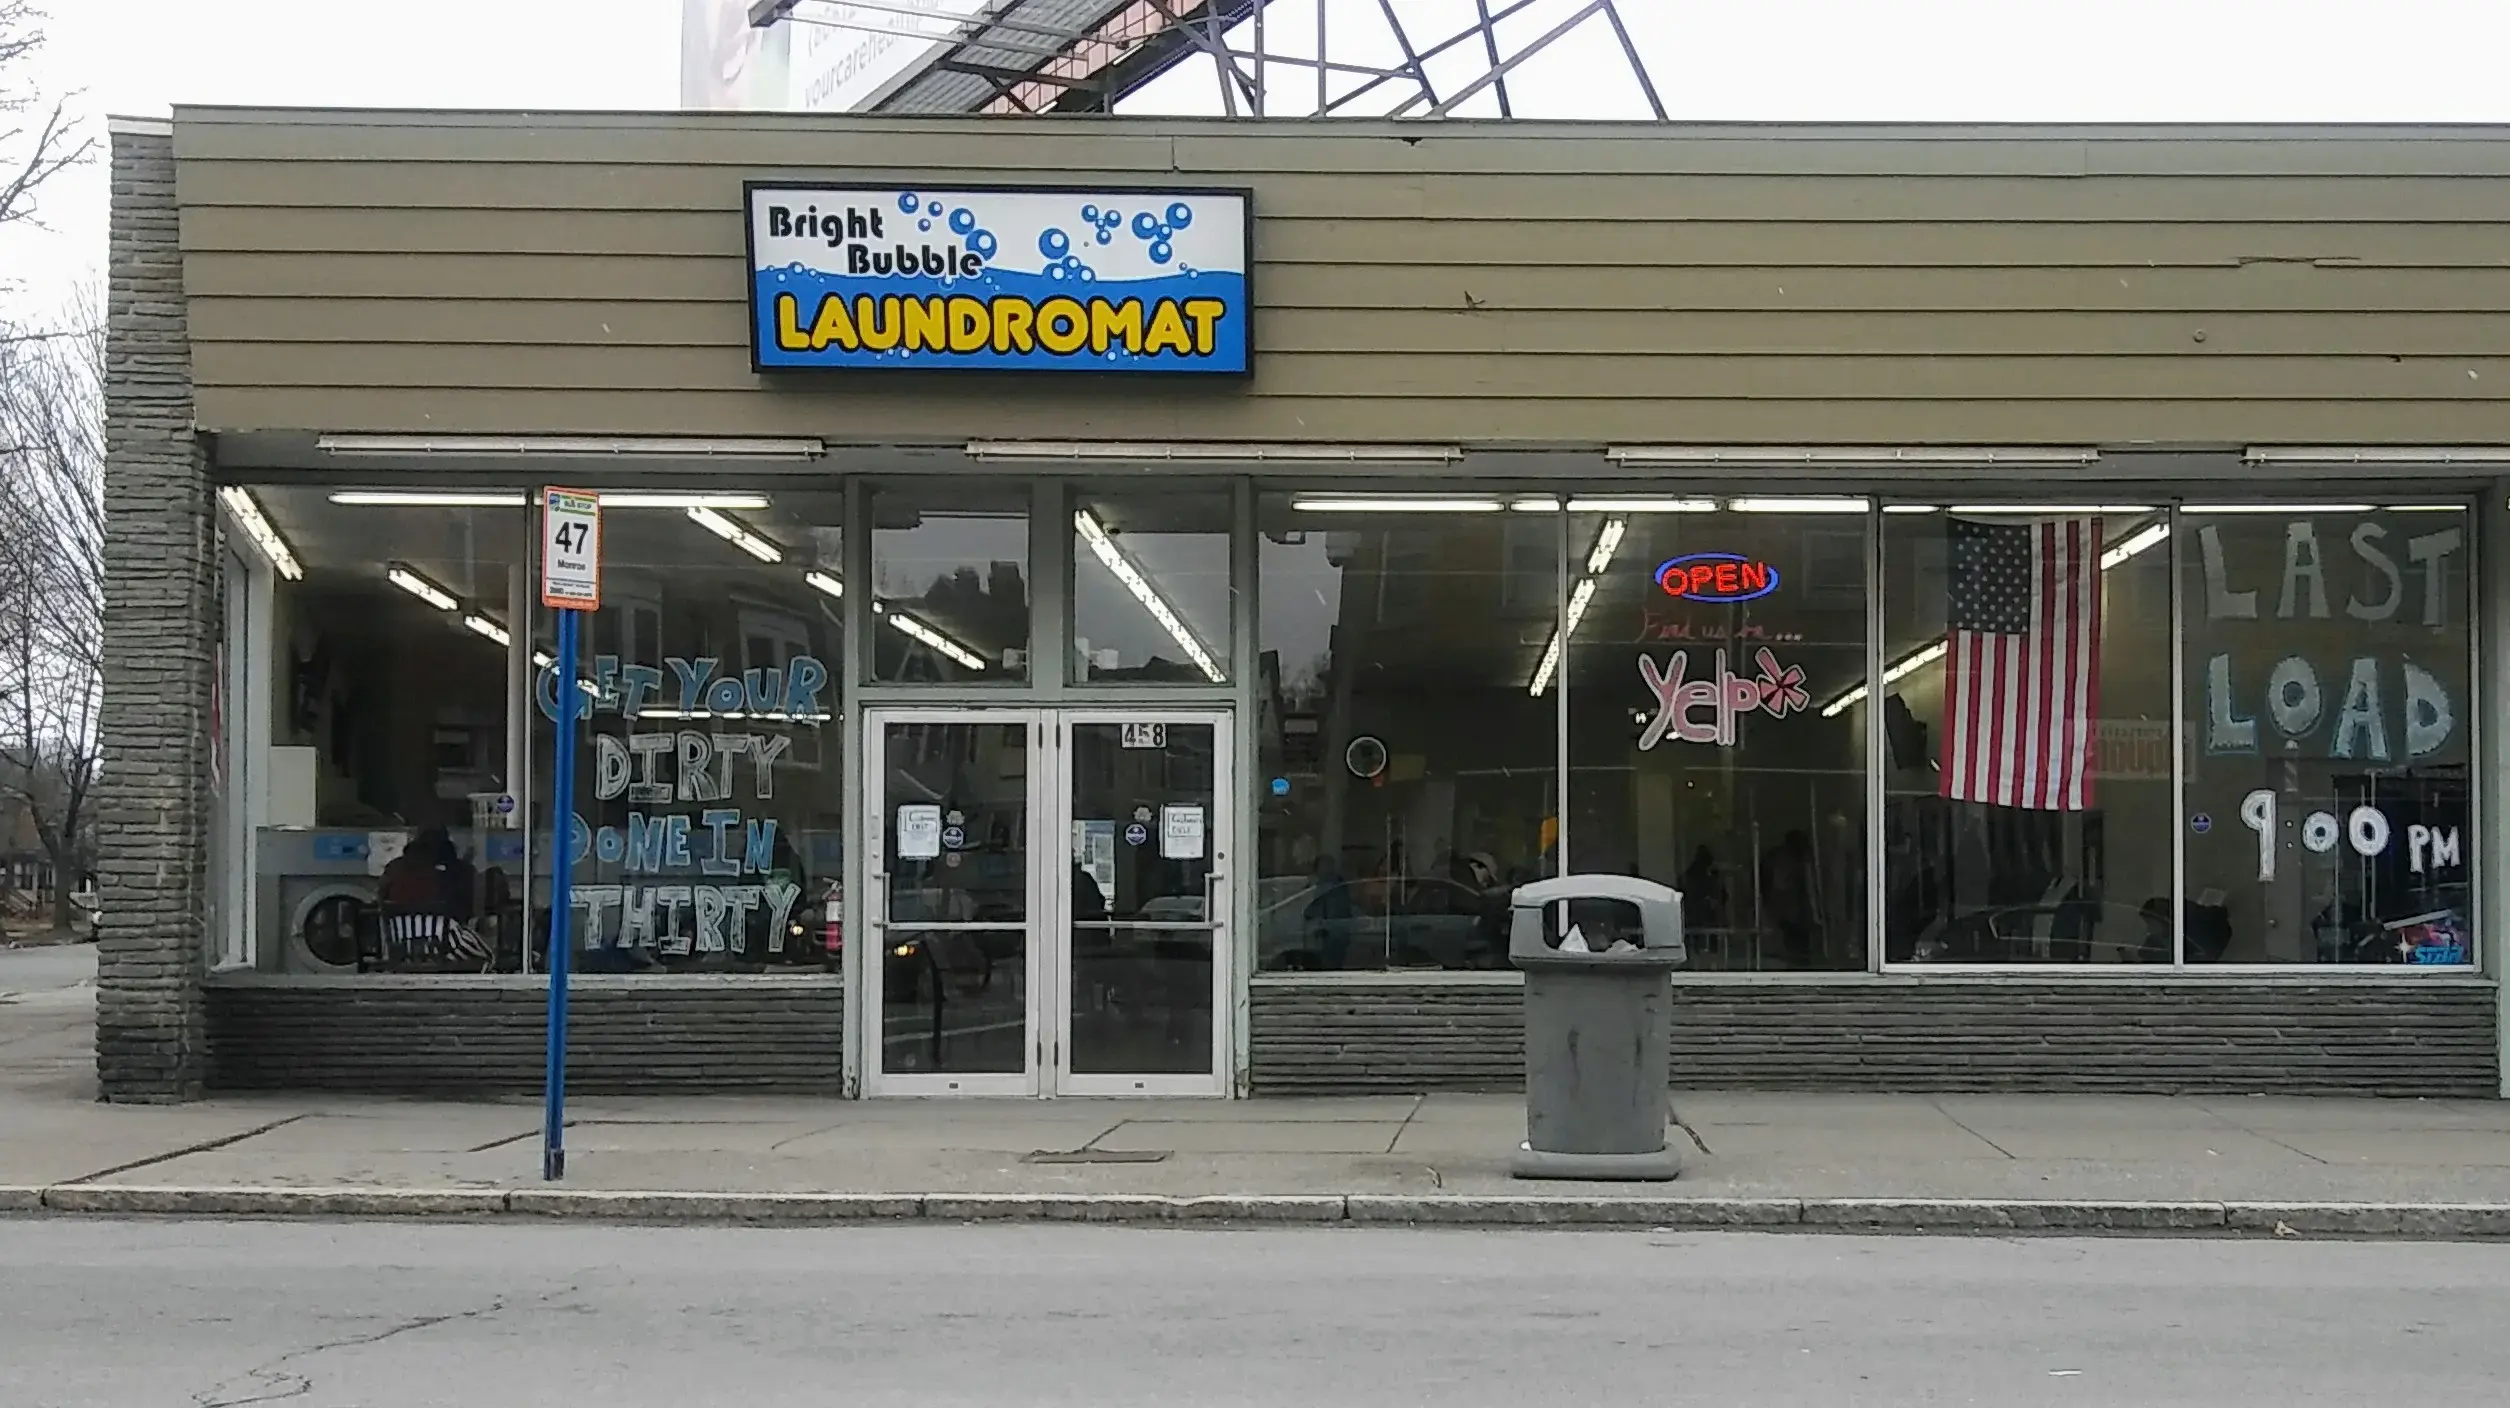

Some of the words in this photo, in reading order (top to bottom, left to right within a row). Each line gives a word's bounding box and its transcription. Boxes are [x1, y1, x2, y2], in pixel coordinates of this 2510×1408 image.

[768, 204, 884, 249] Bright
[846, 243, 983, 278] Bubble
[775, 293, 1227, 356] LAUNDROMAT
[554, 521, 589, 555] 47
[557, 558, 586, 571] Monroe
[1661, 561, 1767, 597] OPEN
[2198, 521, 2462, 629] LAST
[535, 654, 663, 722] GET
[664, 655, 828, 727] YOUR
[2206, 652, 2457, 762] LOAD
[594, 731, 791, 804] DIRTY
[1124, 722, 1165, 747] 458
[701, 808, 778, 877] IN
[2240, 788, 2391, 882] 9:00
[2408, 823, 2461, 874] PM
[568, 883, 801, 954] THIRTY
